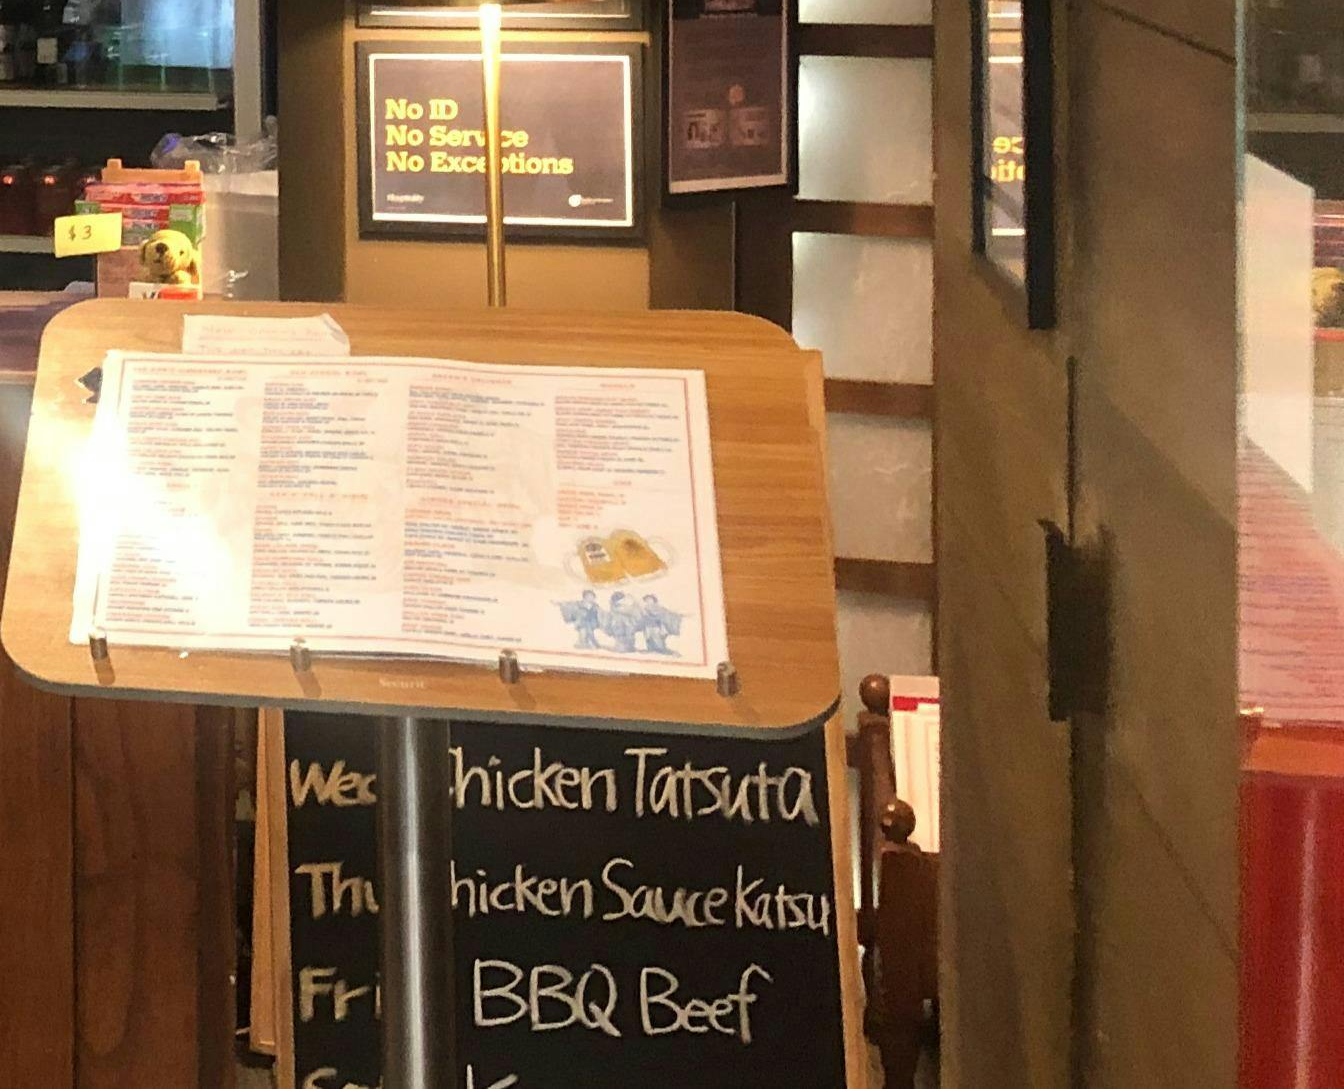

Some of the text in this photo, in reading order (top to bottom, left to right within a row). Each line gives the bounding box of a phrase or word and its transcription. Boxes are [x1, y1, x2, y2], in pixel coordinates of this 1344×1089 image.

[384, 98, 459, 121] No ID
[385, 124, 529, 148] No Servce
[385, 151, 425, 173] No
[449, 746, 617, 811] hicken
[624, 747, 820, 826] Tatsuta
[450, 859, 594, 919] hicken
[602, 857, 728, 927] Sauce
[735, 864, 832, 937] Katsu
[474, 958, 622, 1038] BBQ
[640, 962, 774, 1044] Beef
